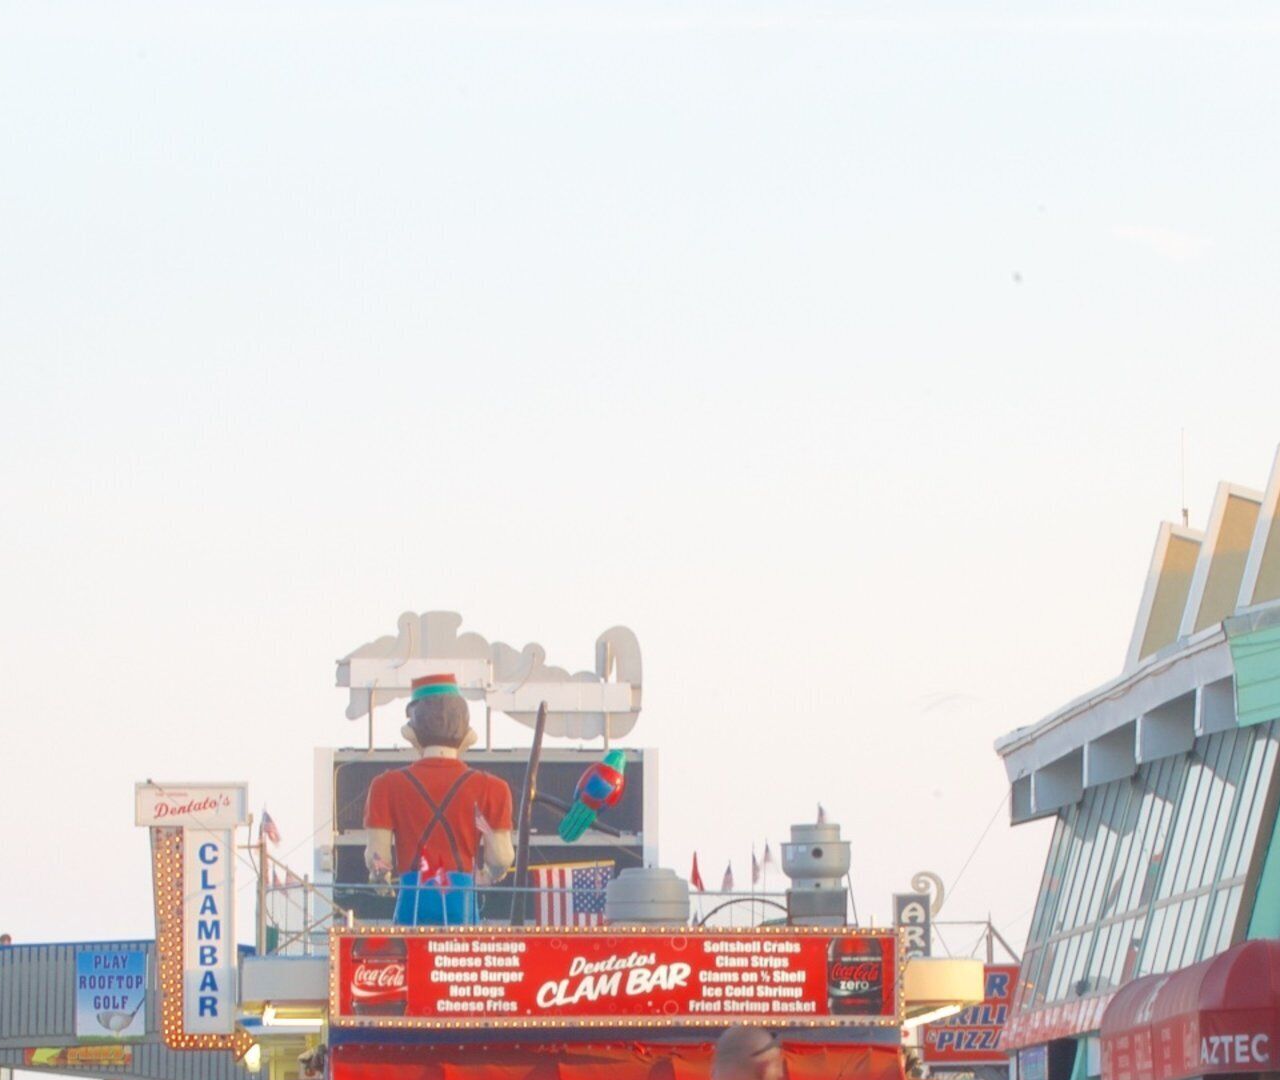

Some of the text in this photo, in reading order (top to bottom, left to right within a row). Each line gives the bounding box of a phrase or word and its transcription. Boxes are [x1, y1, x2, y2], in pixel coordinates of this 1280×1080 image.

[153, 793, 230, 819] Dentato's
[428, 941, 526, 954] Italian Sausage
[703, 941, 801, 953] Softshell Crabs
[93, 954, 129, 969] PLAY
[434, 955, 520, 968] Cheese Steak
[570, 951, 656, 977] Dentatos
[716, 955, 789, 969] Clam Strips
[354, 964, 405, 987] Coca-Cola
[431, 970, 524, 984] Cheese Burger
[699, 970, 739, 983] Clams
[741, 973, 758, 983] on
[773, 970, 805, 983] Shell
[79, 976, 144, 989] ROOFTOP
[535, 962, 692, 1008] CLAM BAR
[839, 981, 869, 991] zero
[450, 985, 505, 998] Hot Dogs
[703, 985, 802, 998] Ice Cold Shrimp
[93, 996, 130, 1010] GOLF
[437, 1000, 518, 1012] Cheese Fries
[689, 1000, 816, 1013] Fried Shrimp Basket
[1200, 1033, 1269, 1065] AZTEC
